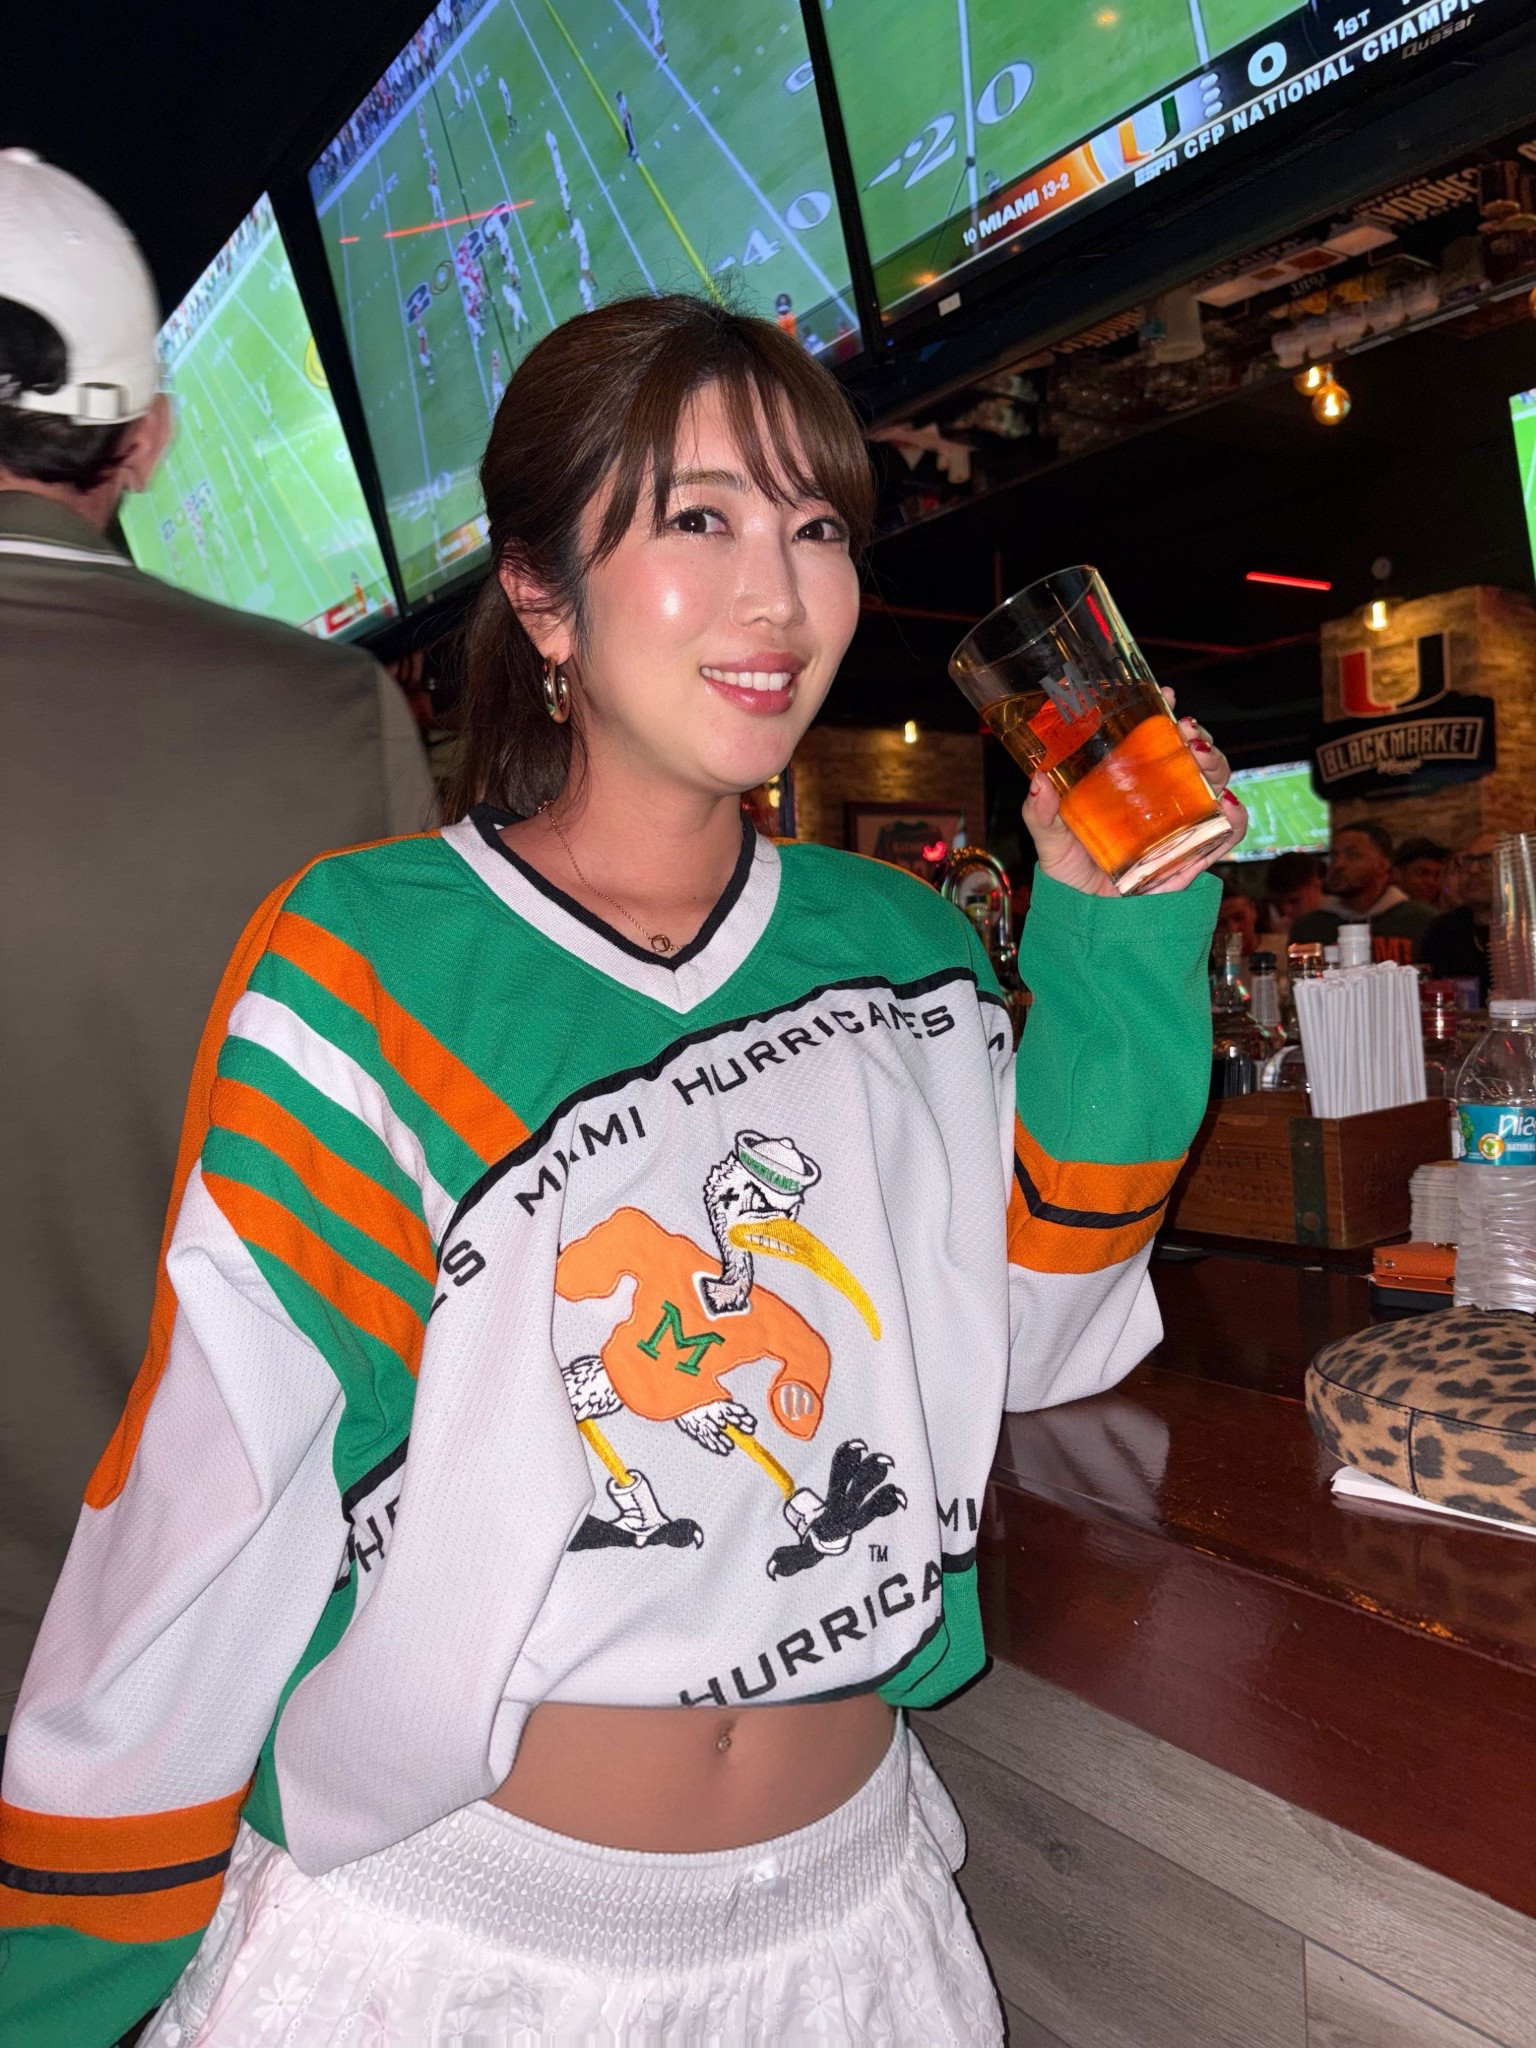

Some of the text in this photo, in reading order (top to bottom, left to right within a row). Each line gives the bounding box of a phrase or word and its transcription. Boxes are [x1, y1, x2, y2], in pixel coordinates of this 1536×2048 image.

[1333, 9, 1371, 41] 1ST
[1401, 13, 1475, 60] Quasar
[1247, 41, 1288, 88] 0
[1135, 150, 1178, 188] ESPN
[1184, 125, 1225, 159] CFP
[1233, 57, 1354, 134] NATIONAL
[962, 172, 1070, 247] 10 MIAMI 13-2
[1498, 1112, 1536, 1136] nia
[636, 1300, 727, 1377] M
[868, 1543, 889, 1562] TM
